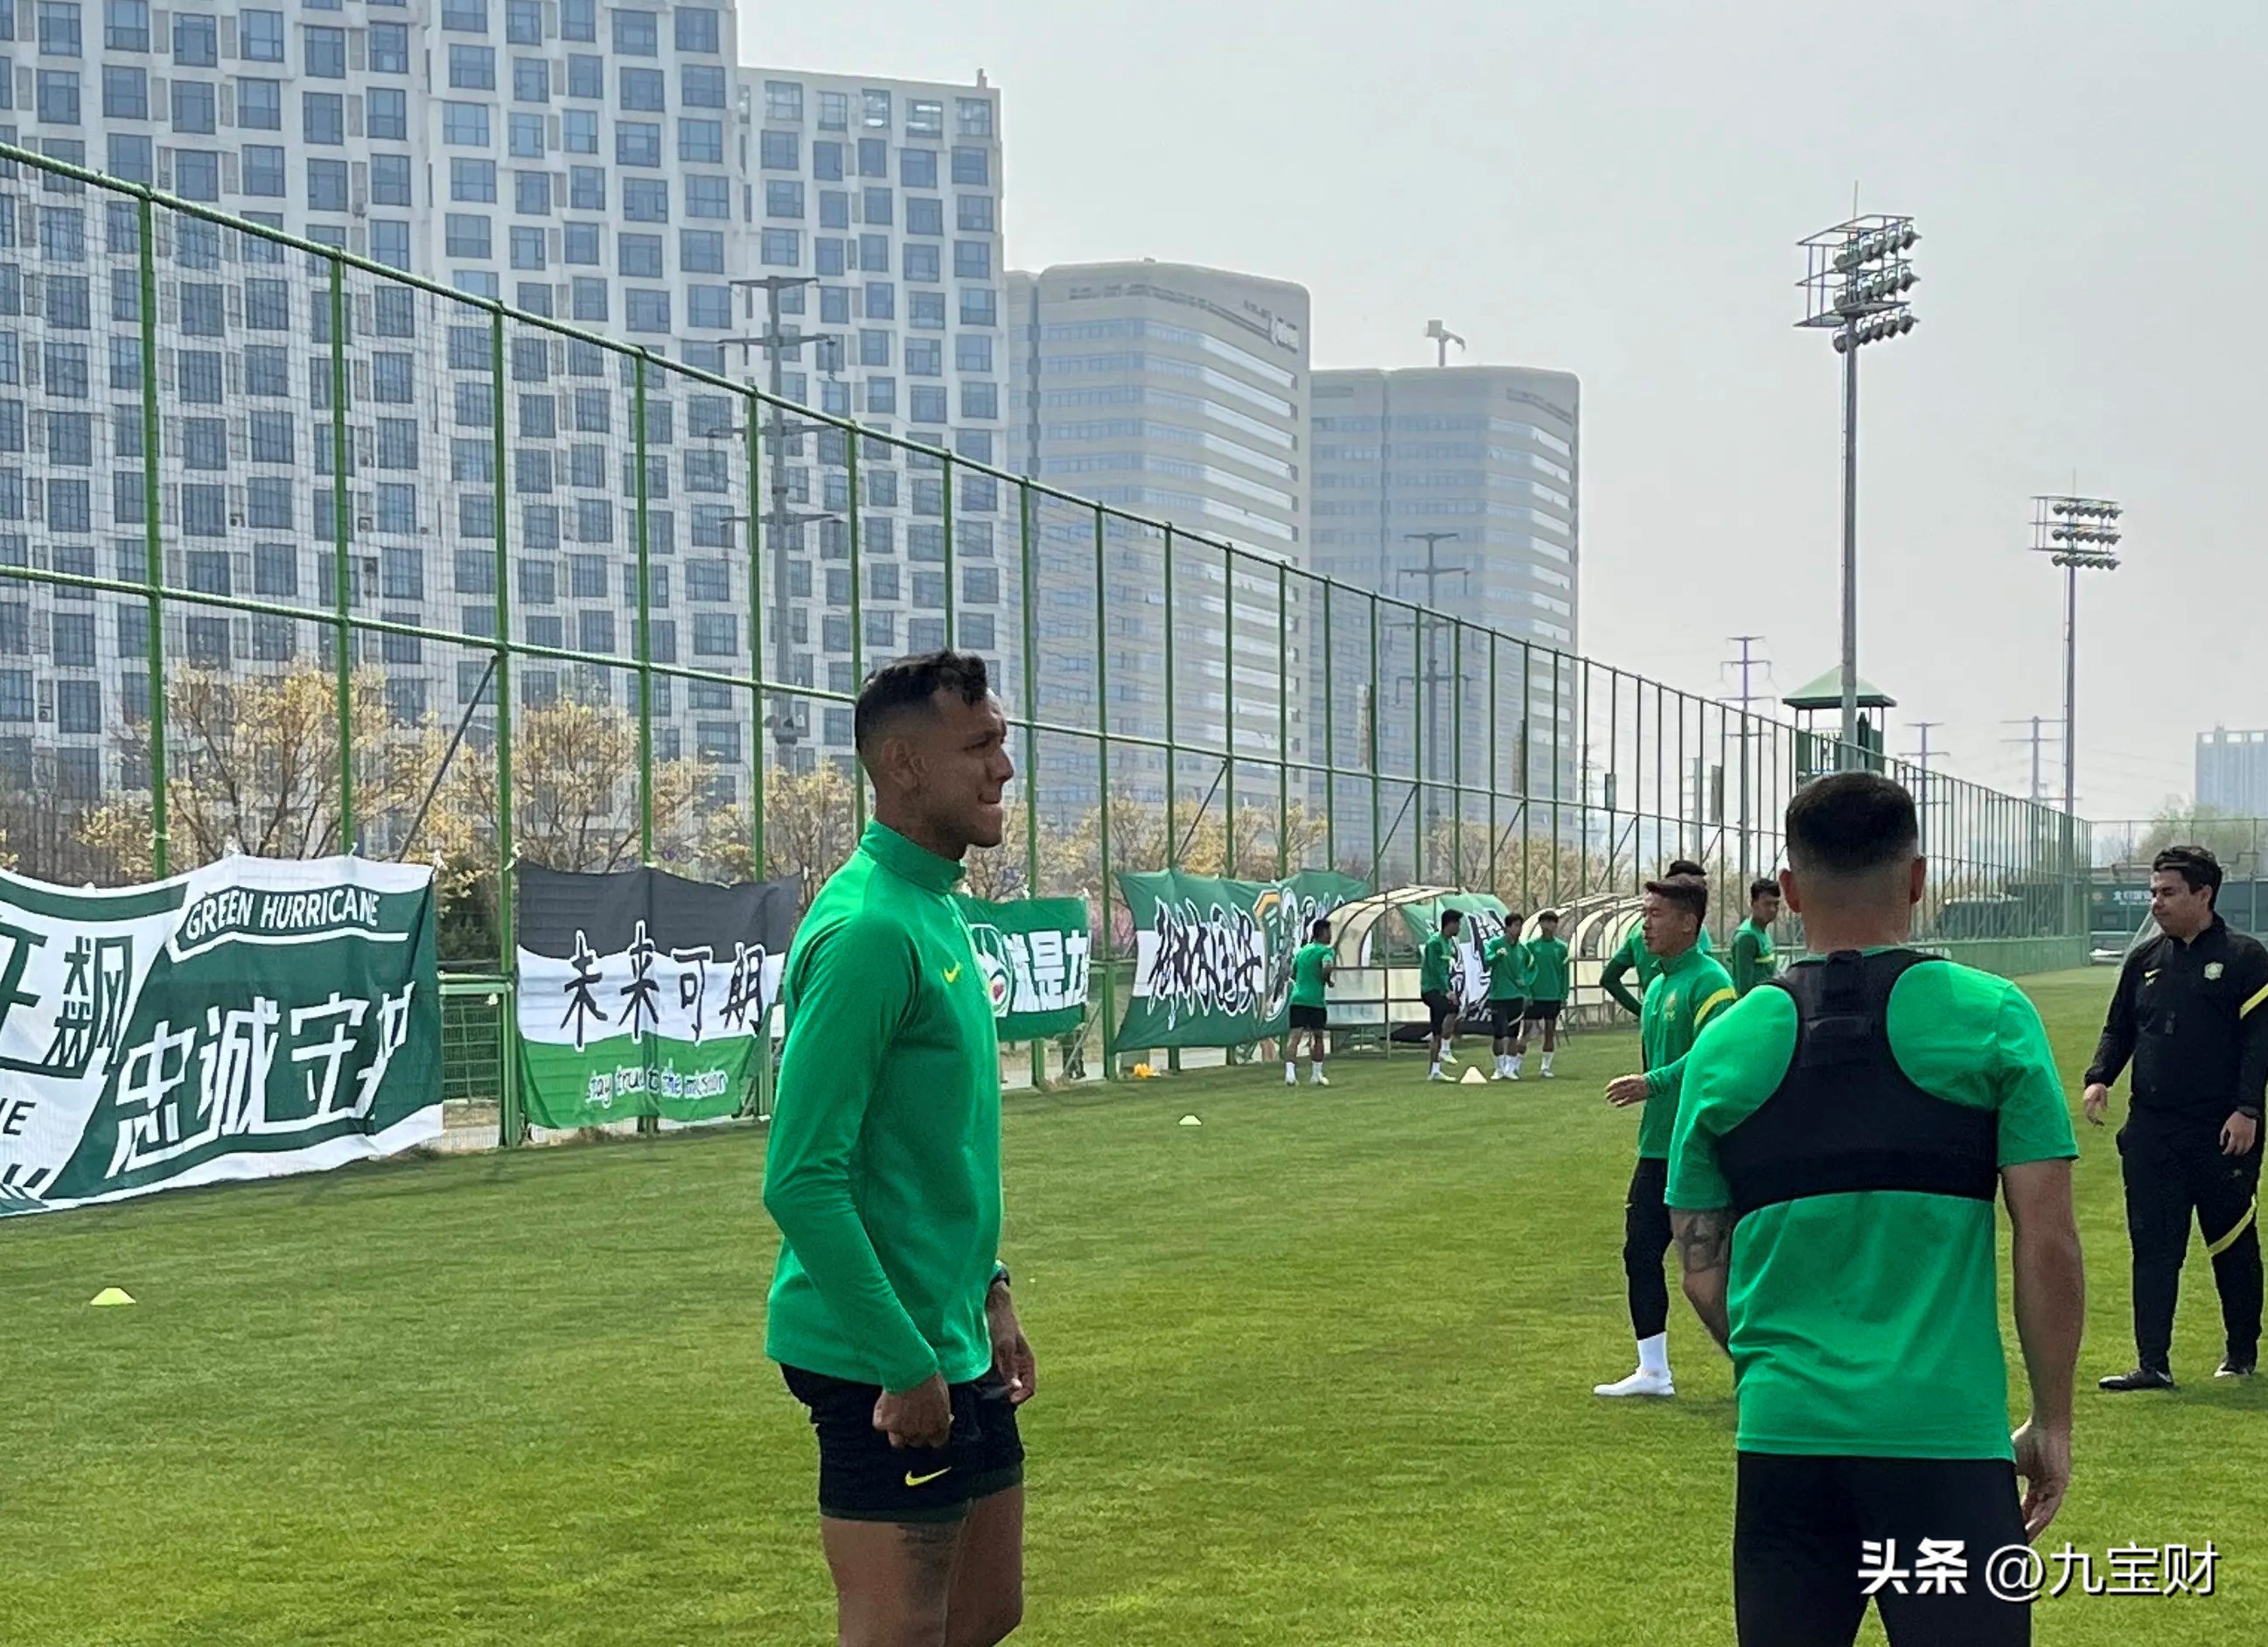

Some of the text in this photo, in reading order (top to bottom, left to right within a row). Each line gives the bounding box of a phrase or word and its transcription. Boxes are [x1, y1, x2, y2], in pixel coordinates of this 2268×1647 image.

[185, 888, 380, 939] GREEN HURRICANE
[560, 919, 765, 1052] 未来可期
